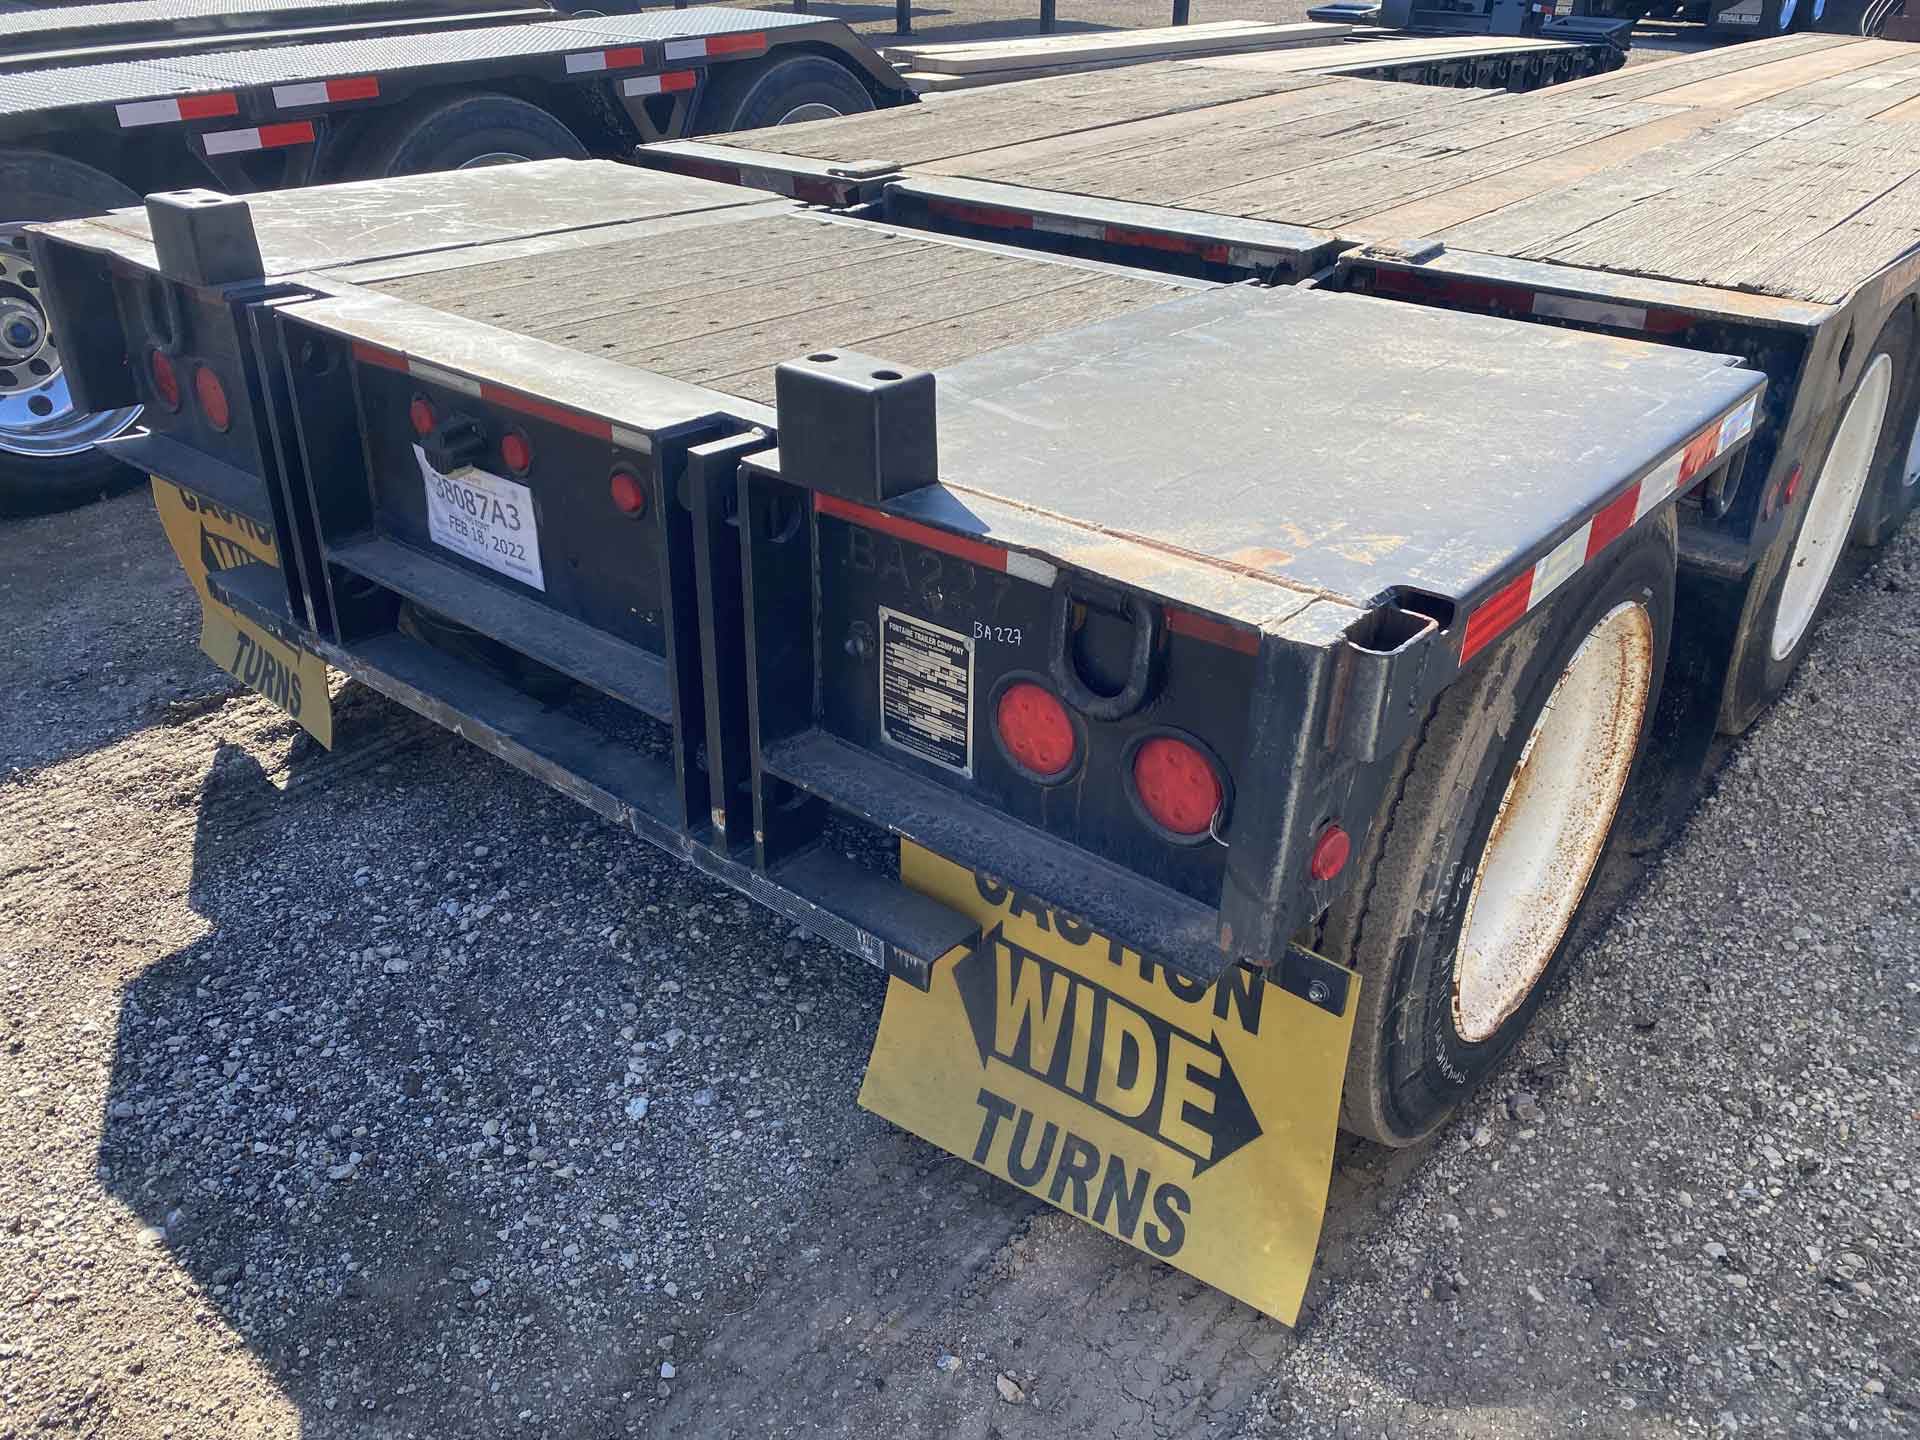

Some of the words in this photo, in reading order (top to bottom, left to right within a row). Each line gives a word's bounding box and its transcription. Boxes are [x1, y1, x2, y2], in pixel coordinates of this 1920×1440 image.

[432, 473, 521, 531] 38087A3
[449, 514, 469, 537] FEB
[491, 535, 526, 561] 2022
[936, 640, 964, 656] COMPANY
[973, 621, 1022, 646] BA227
[231, 631, 302, 718] TURNS
[994, 941, 1223, 1161] WIDE
[971, 1087, 1192, 1258] TURNS
